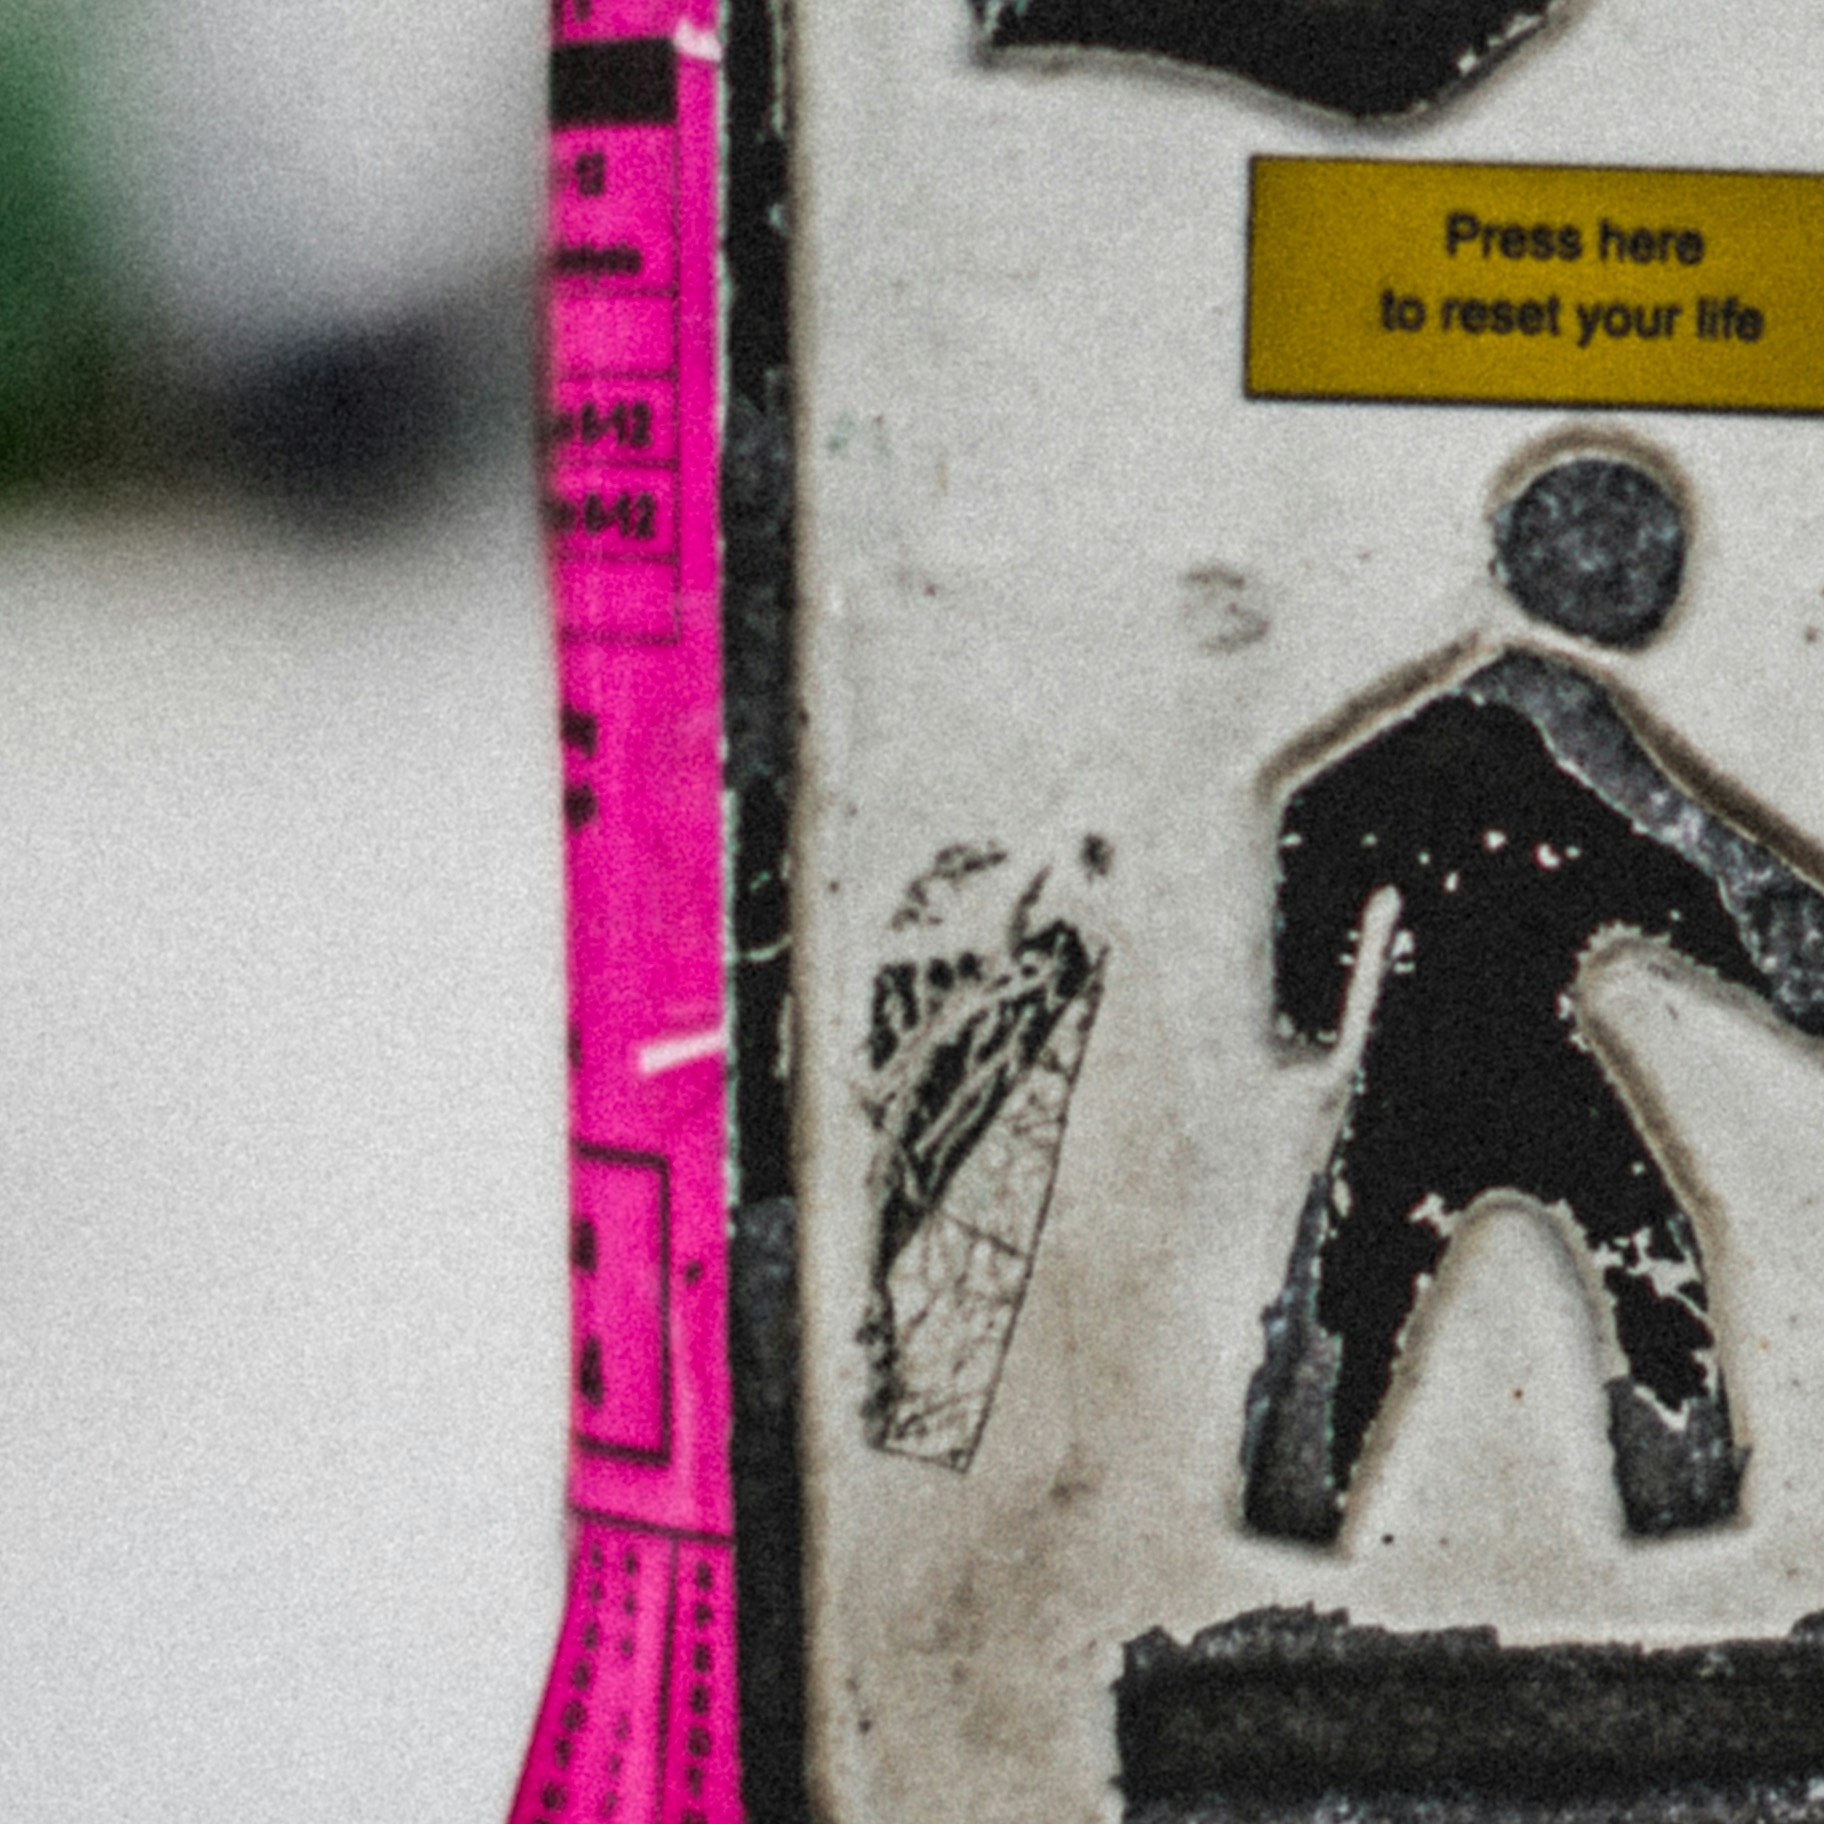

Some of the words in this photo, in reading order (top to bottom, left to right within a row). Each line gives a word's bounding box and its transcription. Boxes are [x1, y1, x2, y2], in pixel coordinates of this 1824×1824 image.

[1443, 211, 1585, 263] Press
[1597, 217, 1706, 267] here
[1379, 287, 1427, 334] to
[1440, 293, 1563, 339] reset
[1574, 298, 1684, 349] your
[1695, 295, 1765, 346] life
